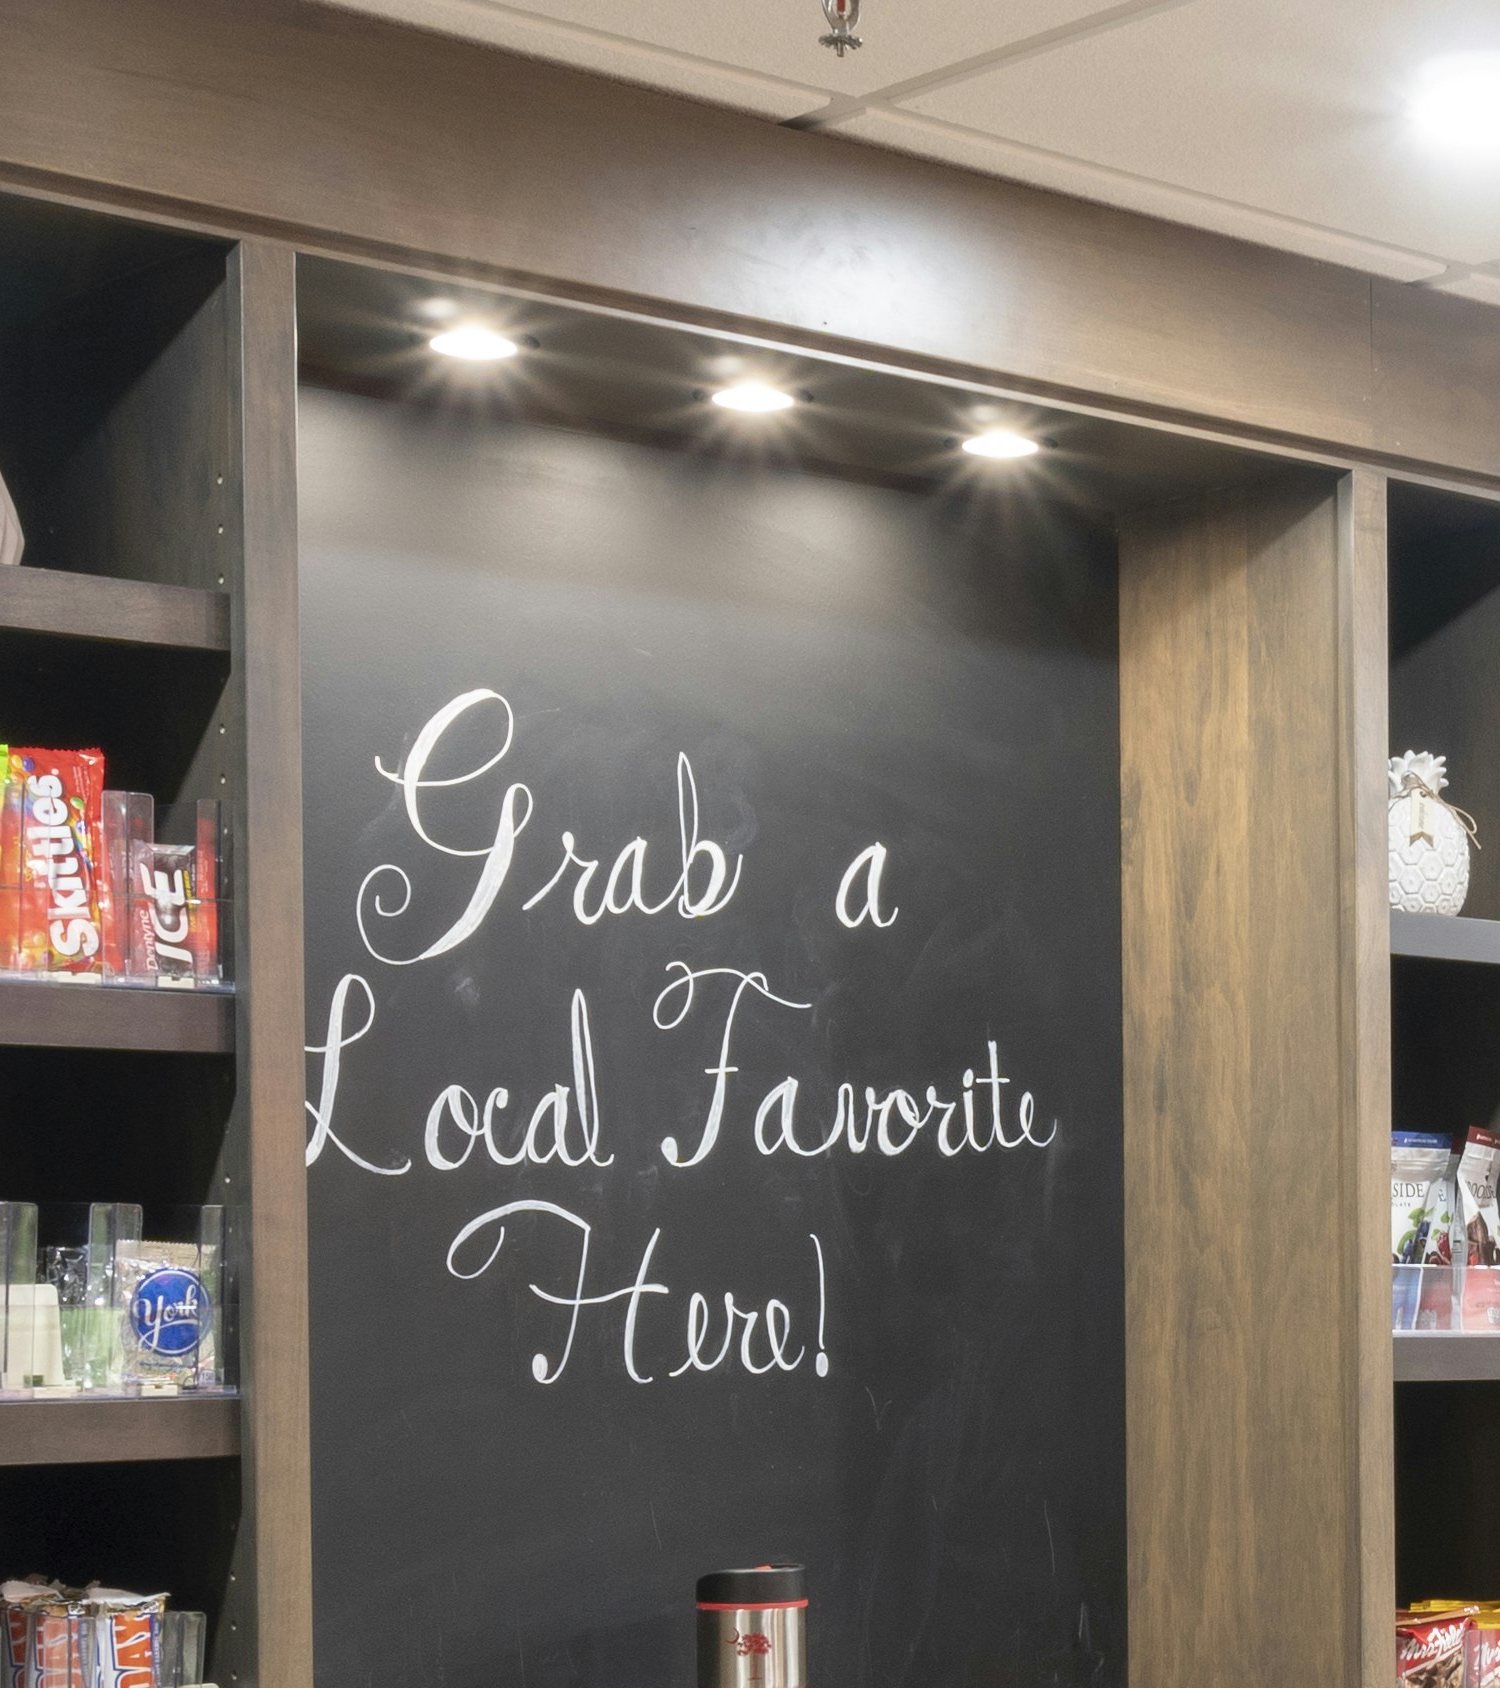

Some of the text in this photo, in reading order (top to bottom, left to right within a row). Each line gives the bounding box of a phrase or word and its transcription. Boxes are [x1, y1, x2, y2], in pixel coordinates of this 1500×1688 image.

[357, 688, 898, 965] Grab a
[131, 908, 160, 973] Dentyne
[140, 861, 194, 965] ICE
[304, 962, 1057, 1174] Local Favorite
[132, 1283, 203, 1352] York
[447, 1200, 830, 1384] Here!
